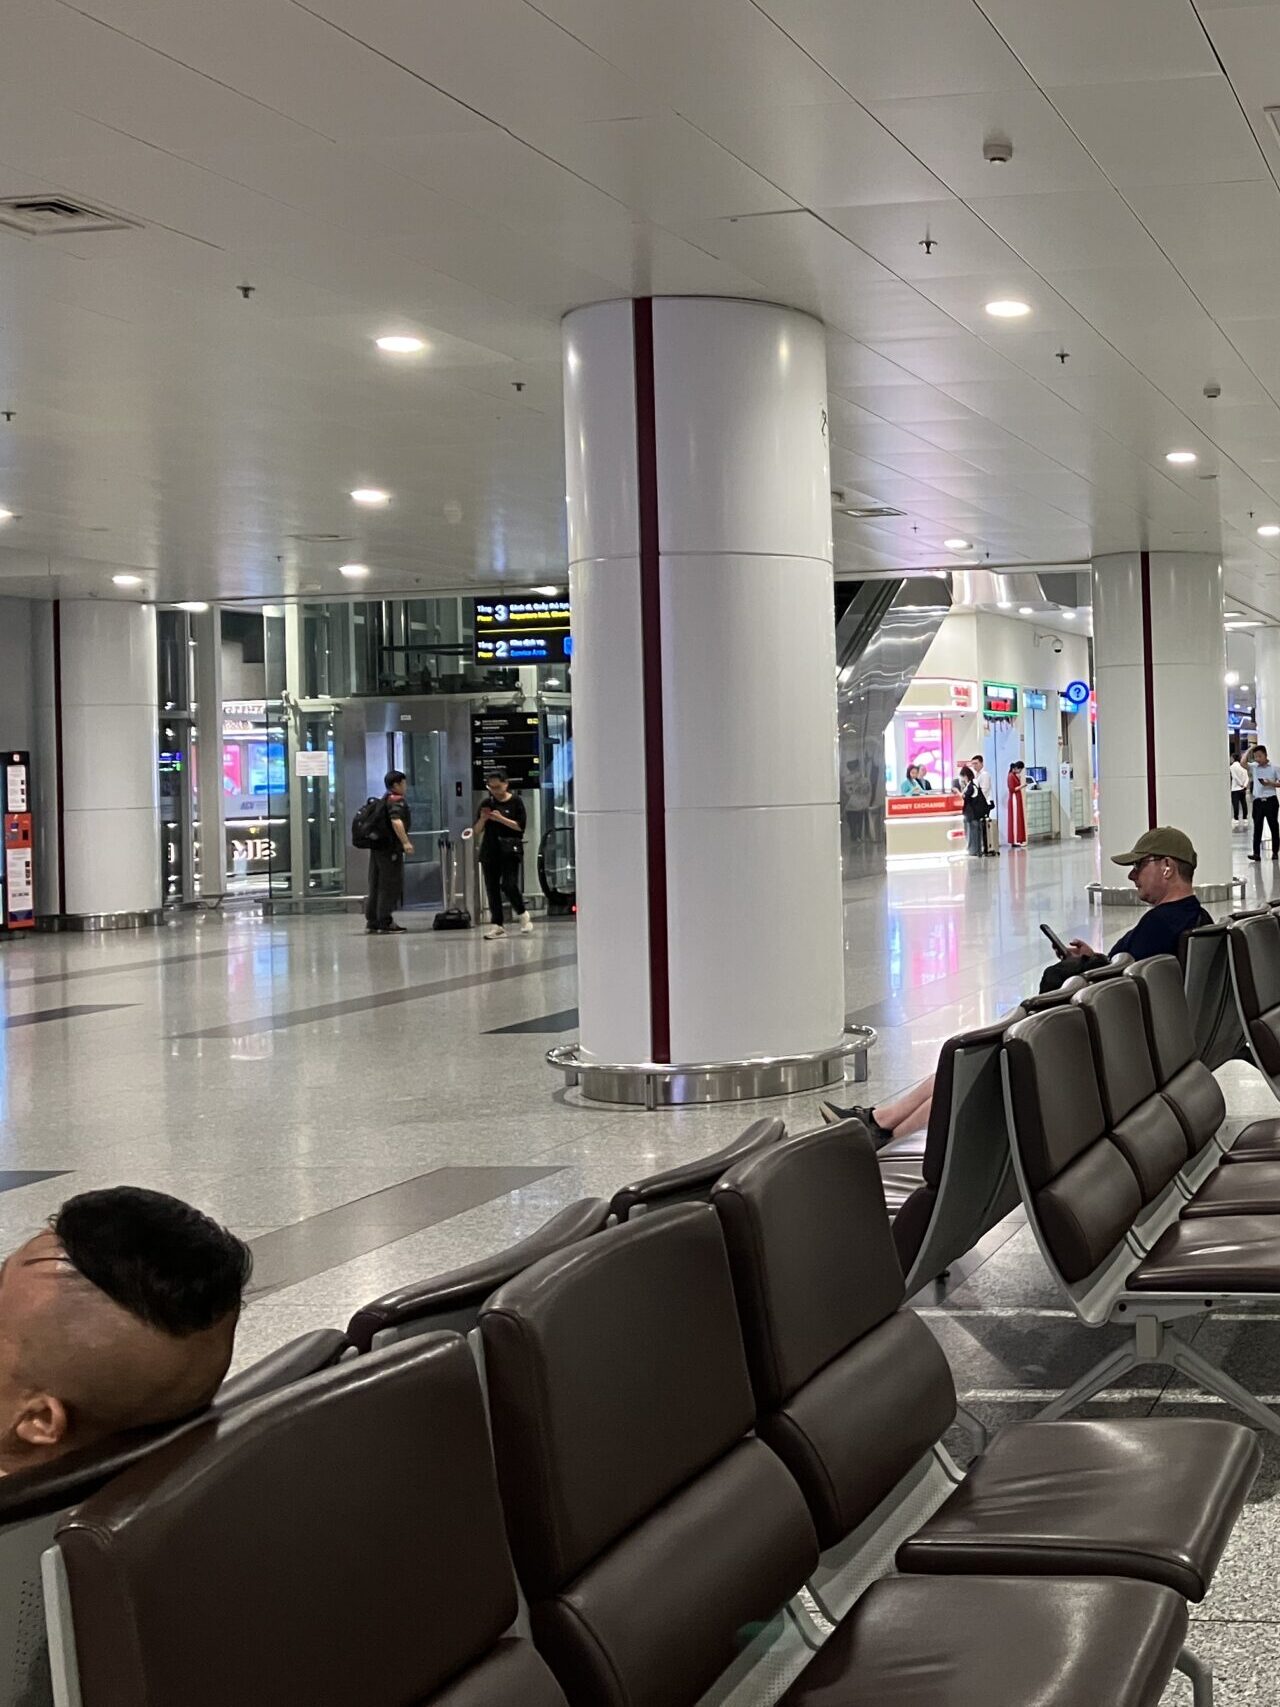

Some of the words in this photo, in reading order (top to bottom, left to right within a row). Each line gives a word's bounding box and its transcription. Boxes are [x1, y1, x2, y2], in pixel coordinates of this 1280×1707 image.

[495, 604, 507, 621] 3
[495, 641, 508, 657] 2
[913, 801, 946, 810] EXCHANGE
